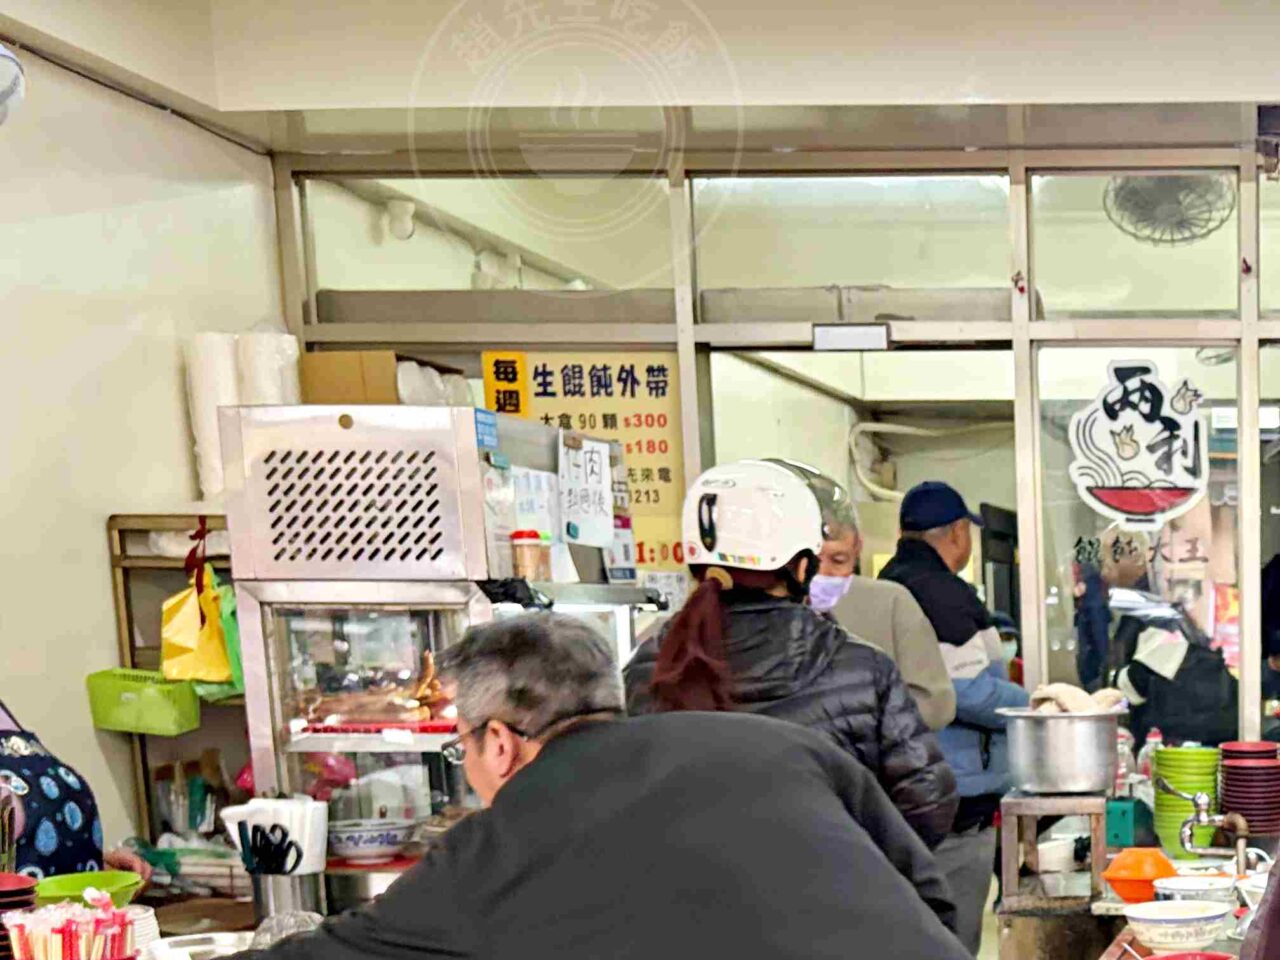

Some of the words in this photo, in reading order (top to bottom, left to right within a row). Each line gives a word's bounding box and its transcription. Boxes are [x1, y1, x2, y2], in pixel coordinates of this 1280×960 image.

[532, 363, 669, 399] 生餛飩外帶
[578, 413, 597, 430] 90
[623, 413, 668, 428] $300
[625, 439, 669, 455] $180
[1073, 535, 1209, 564] 餛飩大王
